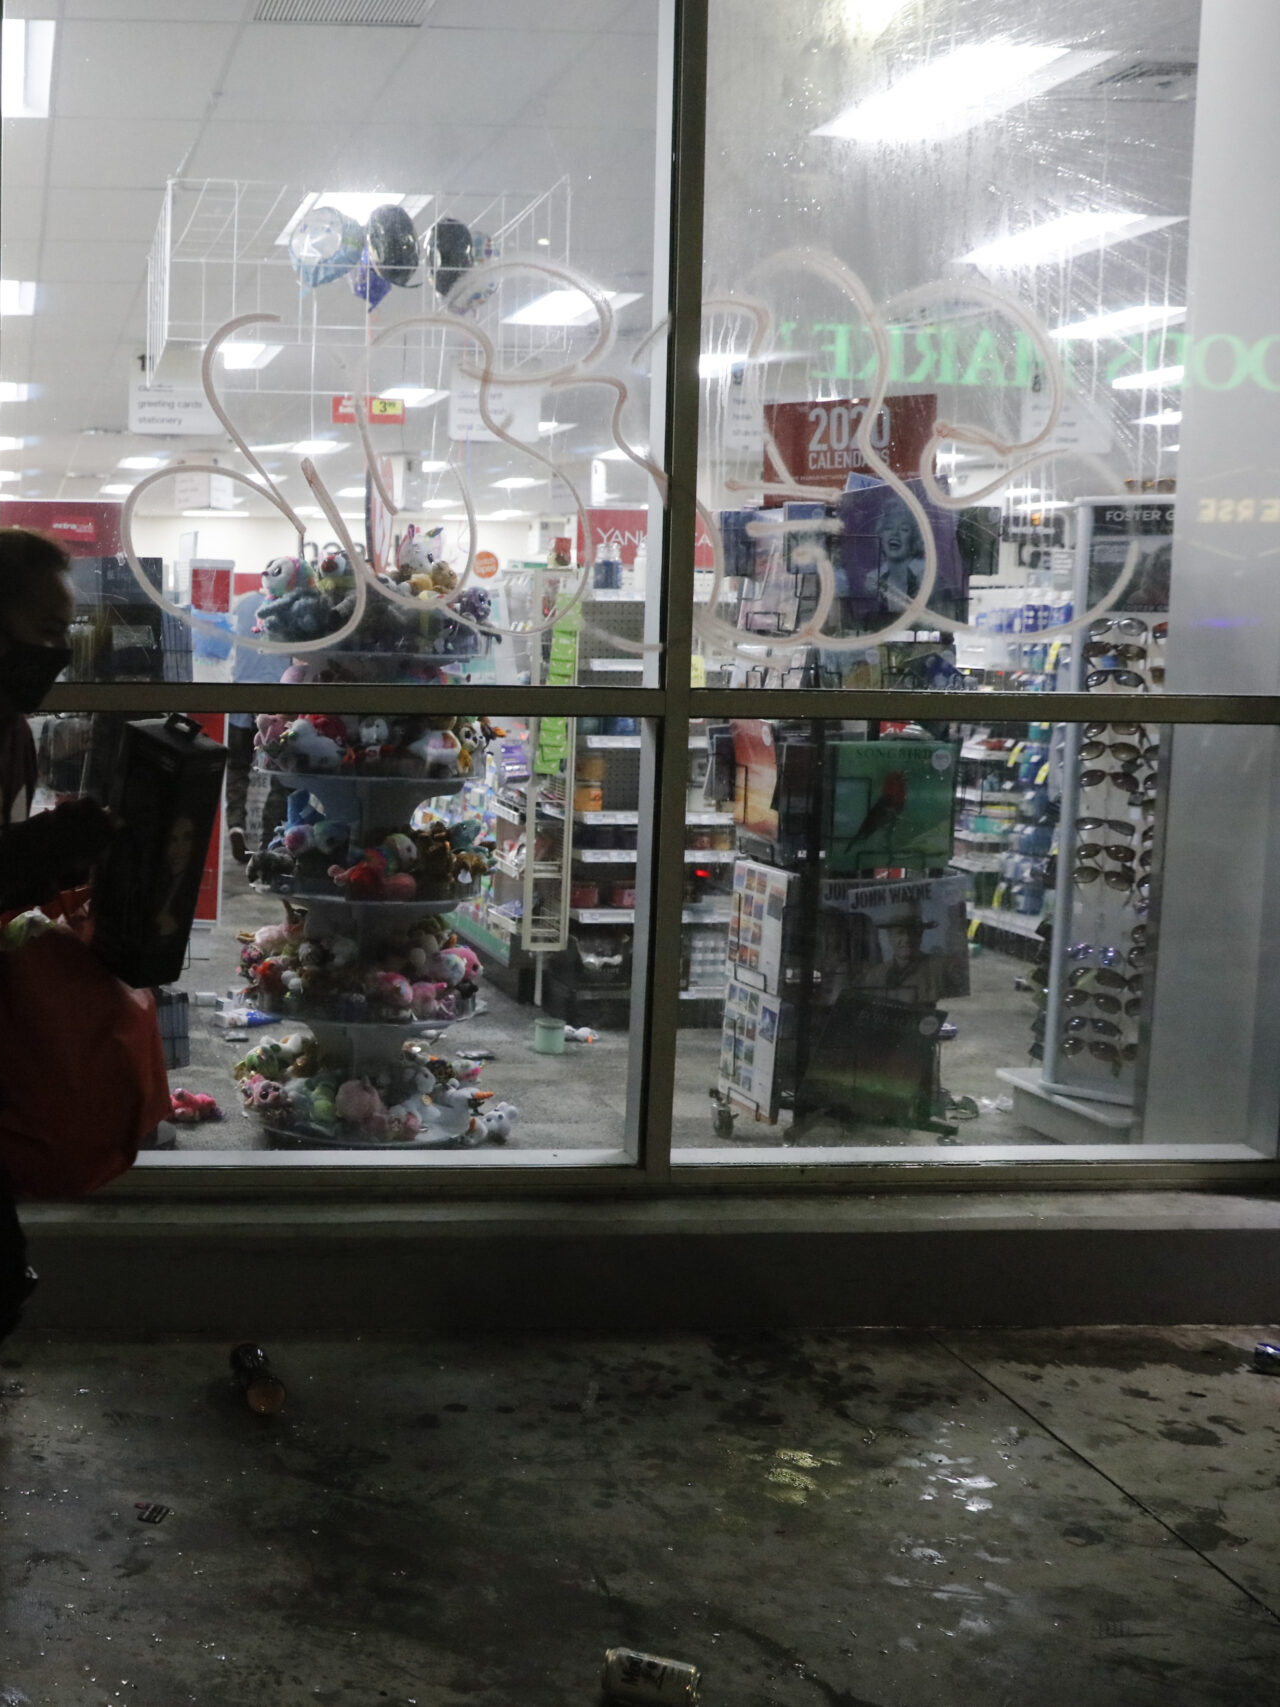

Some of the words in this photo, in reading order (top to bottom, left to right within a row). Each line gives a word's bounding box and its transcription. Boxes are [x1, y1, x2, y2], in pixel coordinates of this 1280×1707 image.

[138, 401, 175, 410] greeting
[177, 400, 203, 408] cards
[138, 416, 182, 426] stationery
[808, 404, 891, 451] 2020
[1106, 510, 1161, 521] FOSTER
[850, 889, 887, 910] JOHN
[889, 882, 933, 905] WAYNE
